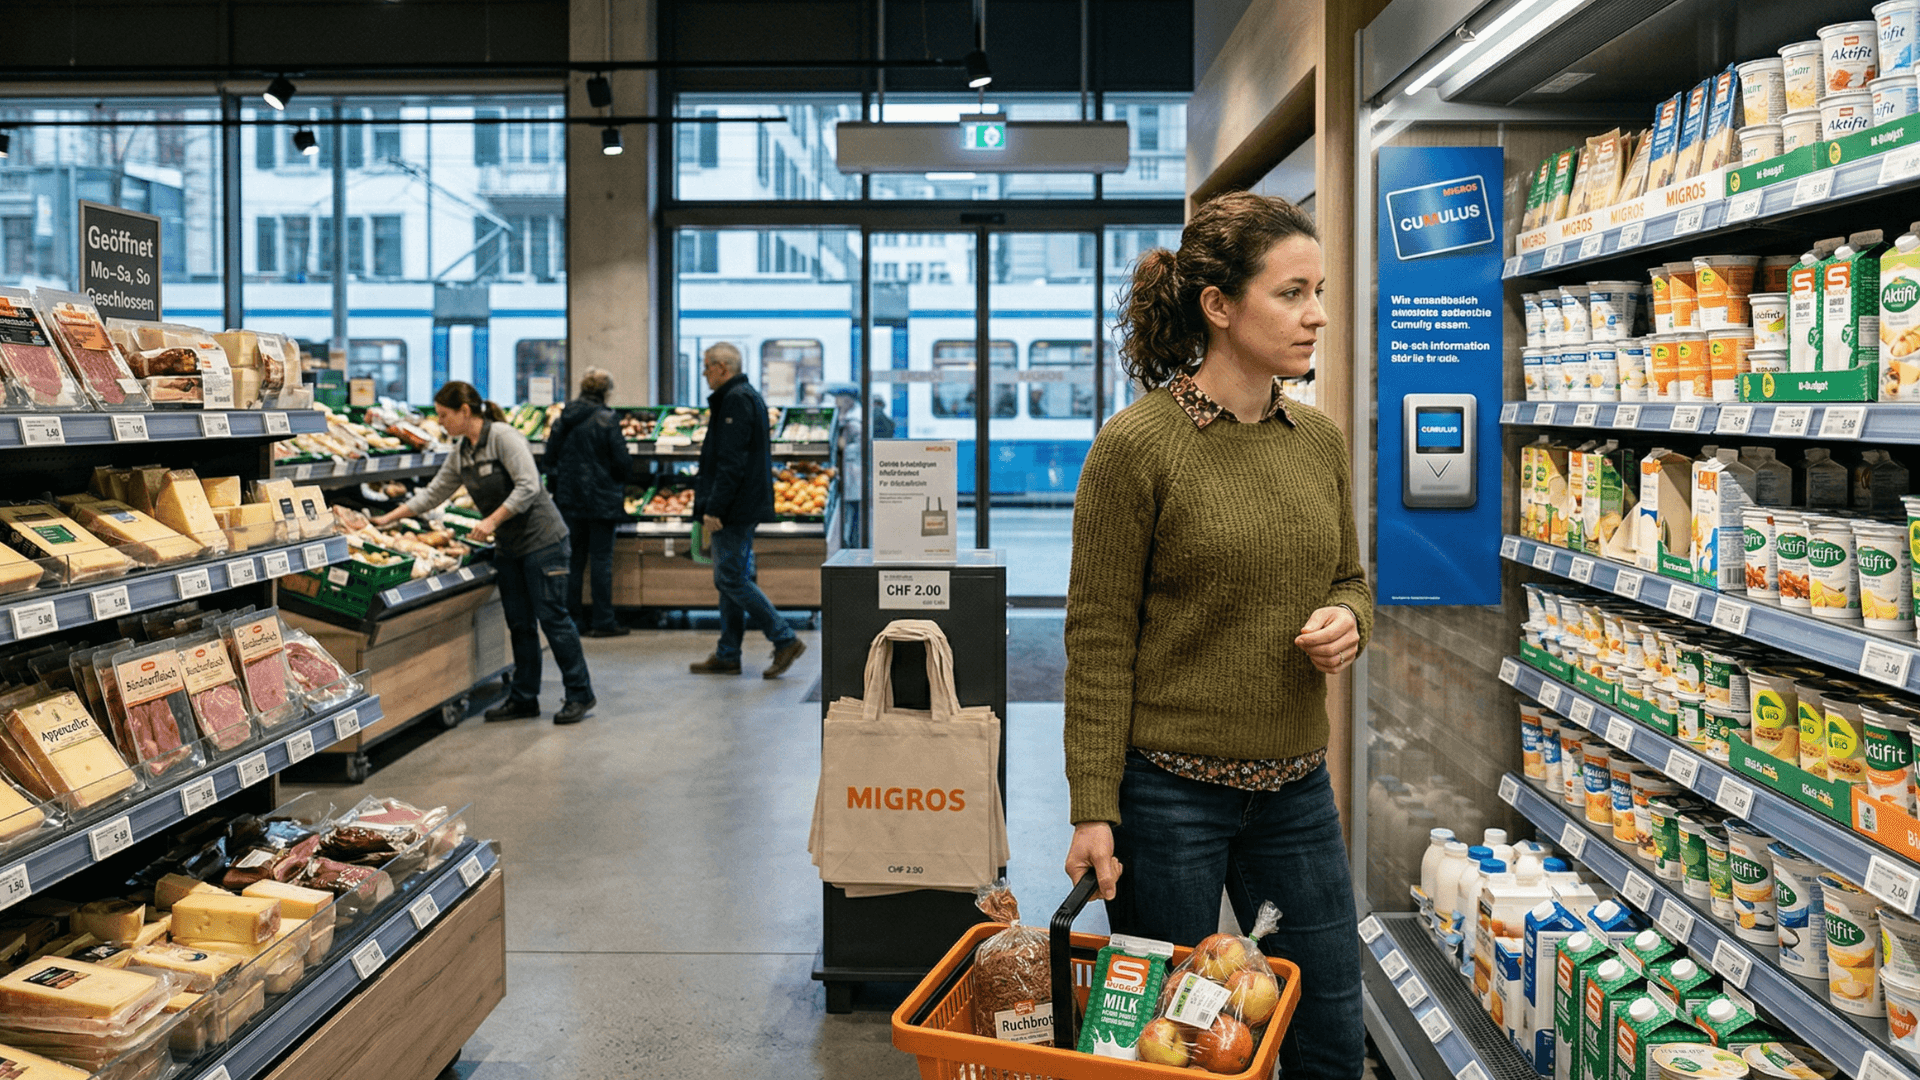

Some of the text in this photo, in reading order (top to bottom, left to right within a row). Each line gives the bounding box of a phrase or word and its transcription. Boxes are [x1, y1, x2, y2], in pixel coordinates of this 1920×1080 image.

[1830, 46, 1873, 61] Aktifit
[1827, 116, 1868, 132] Aktifit
[1666, 181, 1706, 207] MIGROS
[1400, 204, 1481, 232] CUMULUS
[1610, 202, 1645, 225] MIGROS
[88, 224, 154, 259] Geöffnet
[136, 267, 151, 286] So
[86, 287, 154, 312] Geschlossen
[1883, 282, 1919, 304] Aktifit
[886, 584, 942, 597] CHF 2.00
[1883, 662, 1900, 676] 3.90
[41, 717, 90, 744] Appenzeller
[847, 786, 966, 812] MIGROS
[1890, 883, 1909, 901] 2.00
[1103, 993, 1140, 1014] MILK
[1002, 1014, 1054, 1032] Ruchbrot
